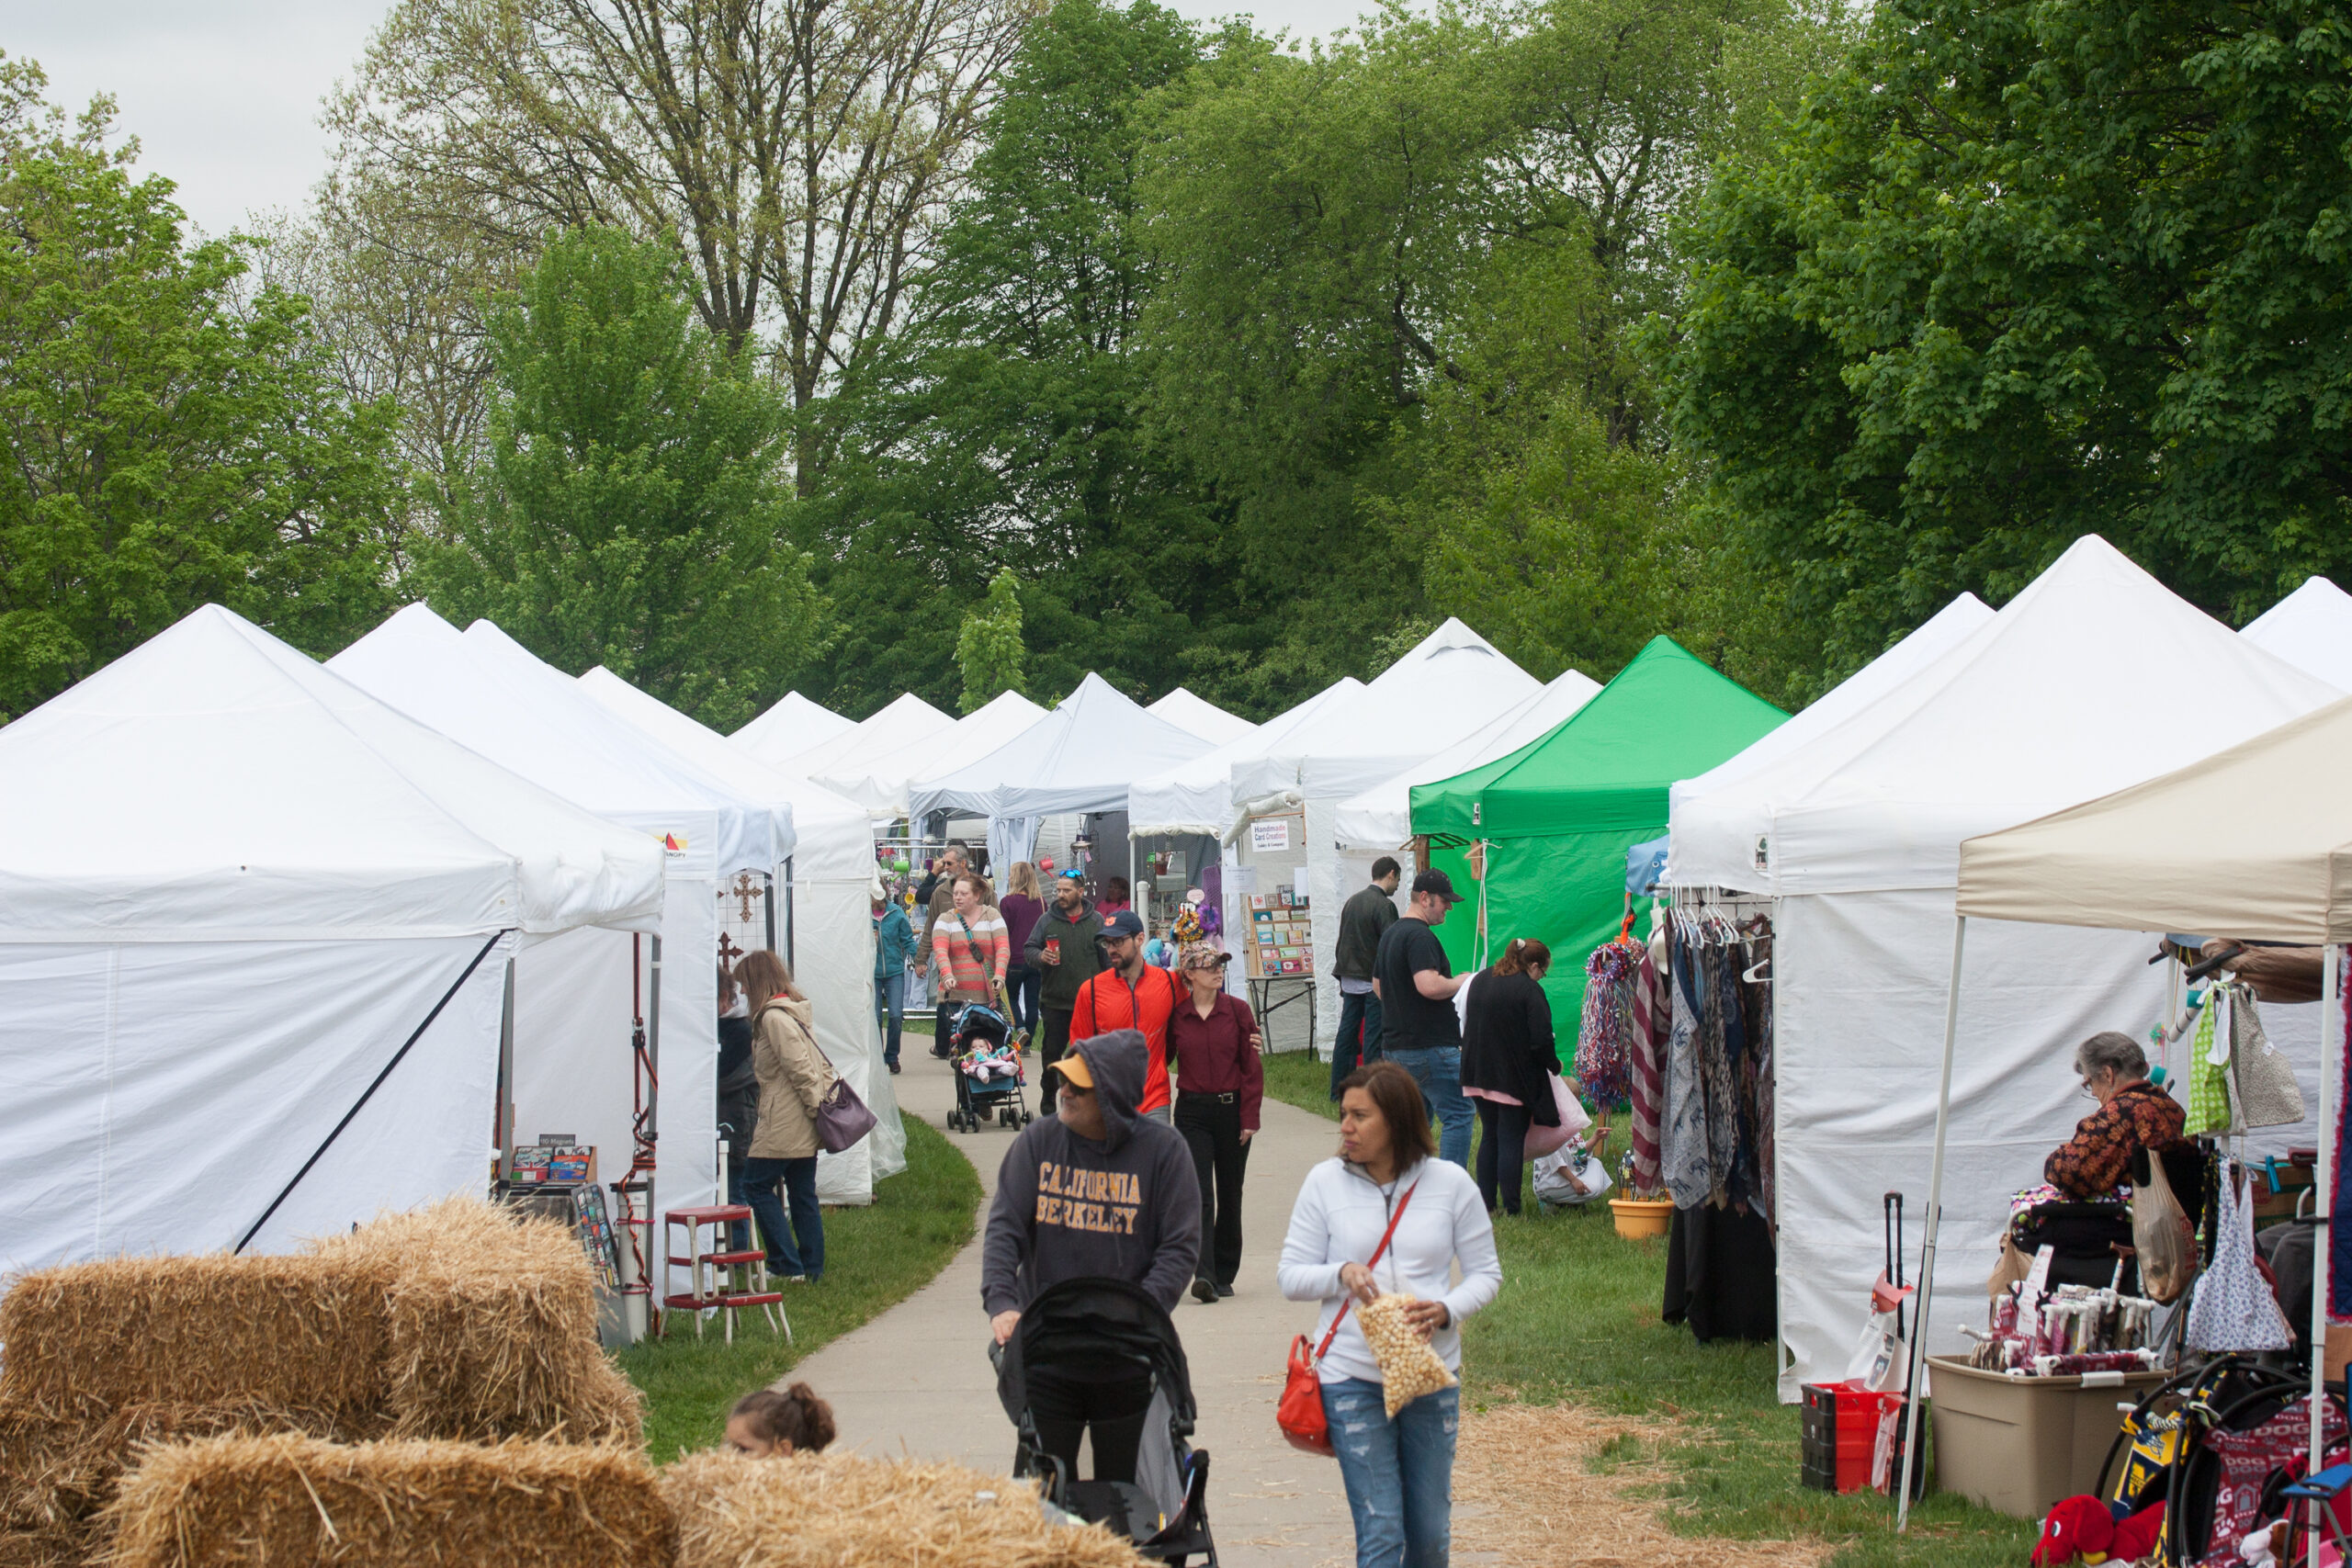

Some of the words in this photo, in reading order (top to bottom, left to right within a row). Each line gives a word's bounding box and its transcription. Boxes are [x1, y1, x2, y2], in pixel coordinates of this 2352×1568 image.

[1038, 1161, 1141, 1204] CALIFORNIA
[1035, 1194, 1137, 1235] BERKELEY
[2255, 1423, 2310, 1437] DOG
[2225, 1457, 2266, 1466] DOG
[2228, 1465, 2267, 1475] DOG
